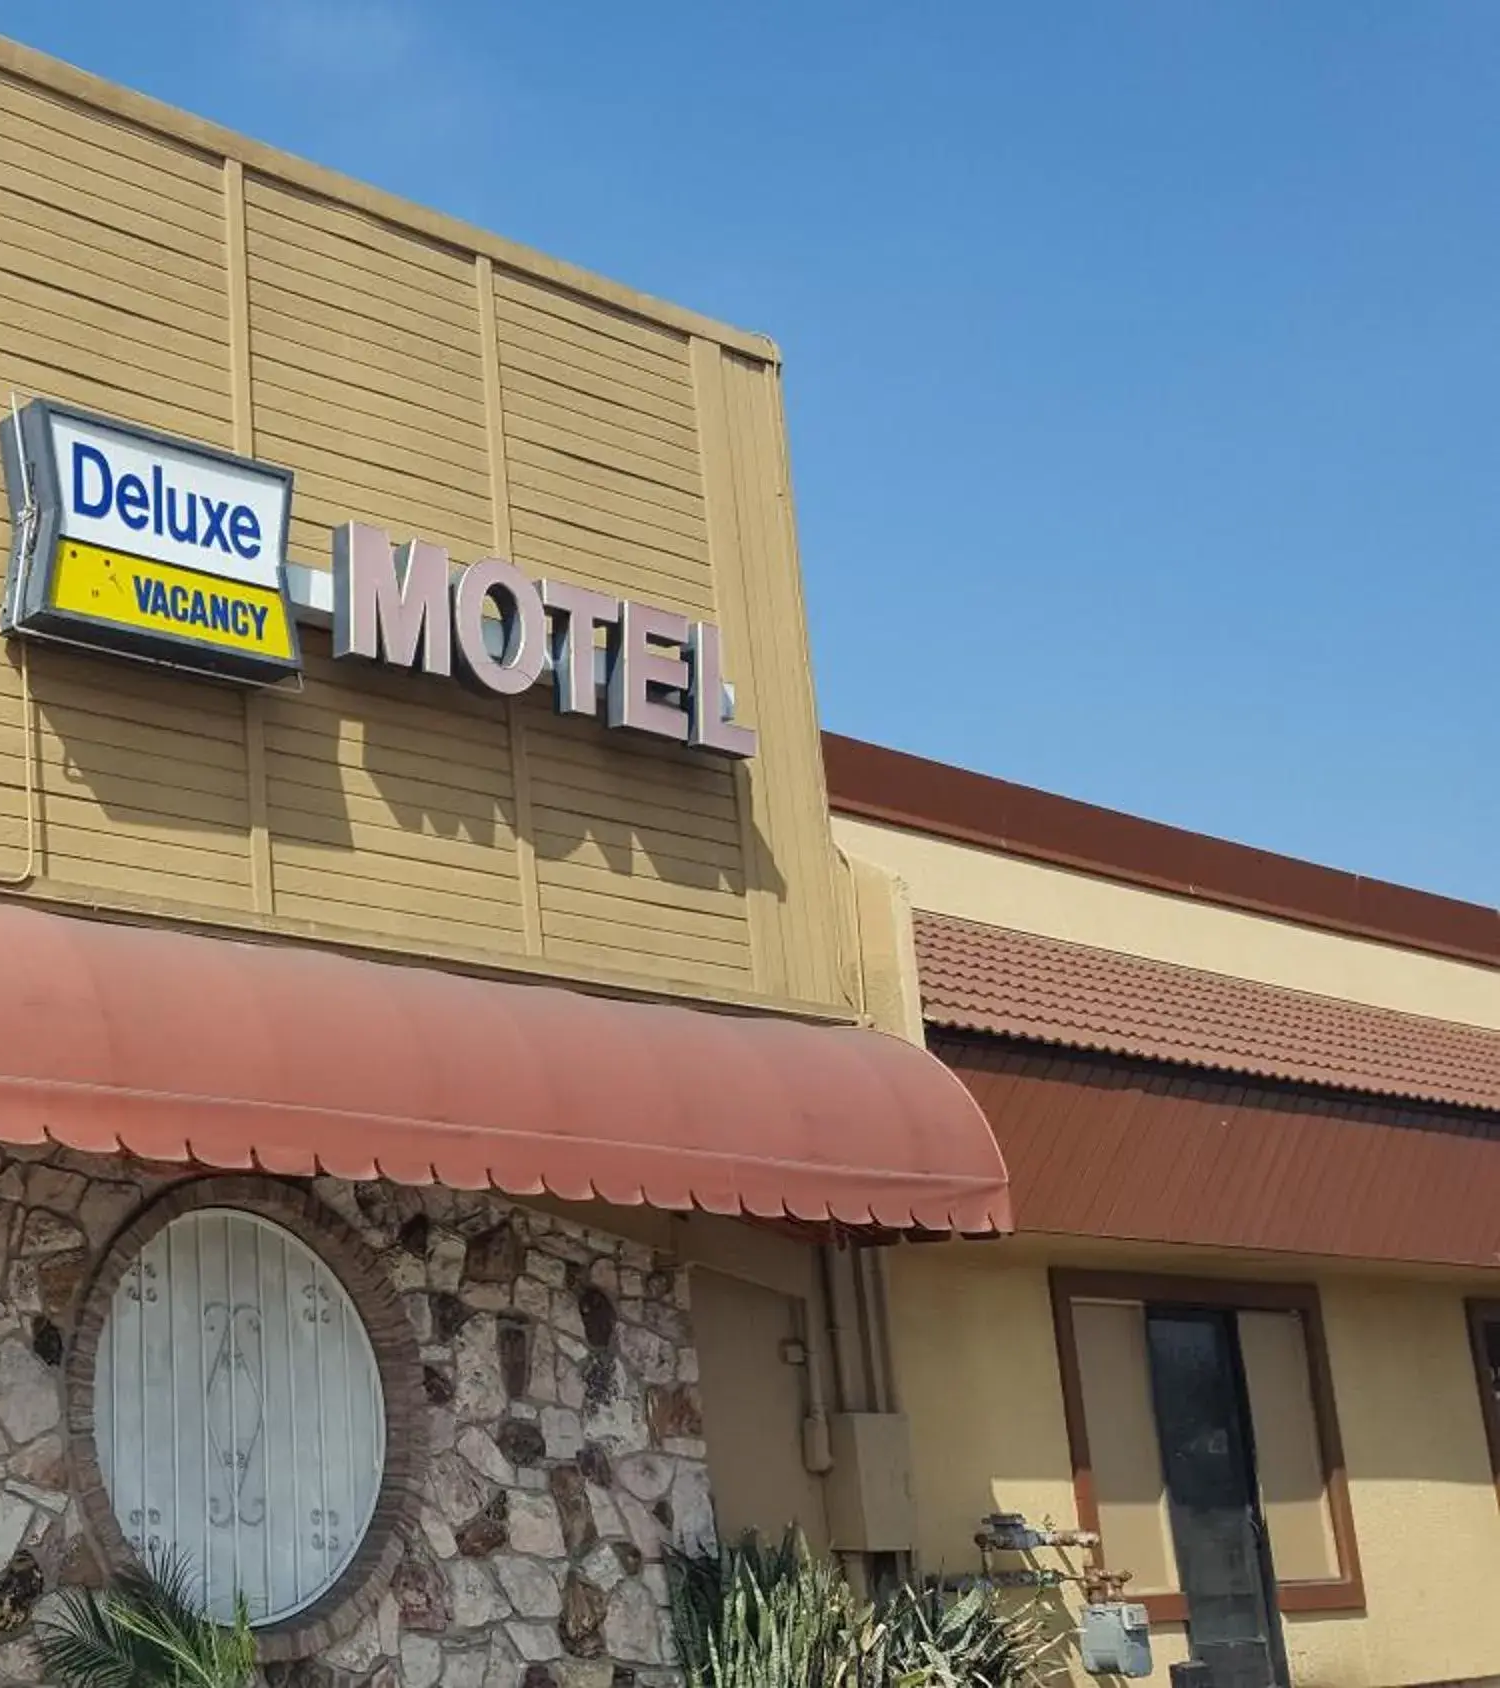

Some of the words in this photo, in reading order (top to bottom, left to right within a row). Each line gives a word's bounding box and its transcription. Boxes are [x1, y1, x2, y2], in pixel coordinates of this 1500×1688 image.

[71, 441, 262, 560] Deluxe
[132, 574, 269, 641] VACANCY
[334, 520, 757, 759] MOTEL
